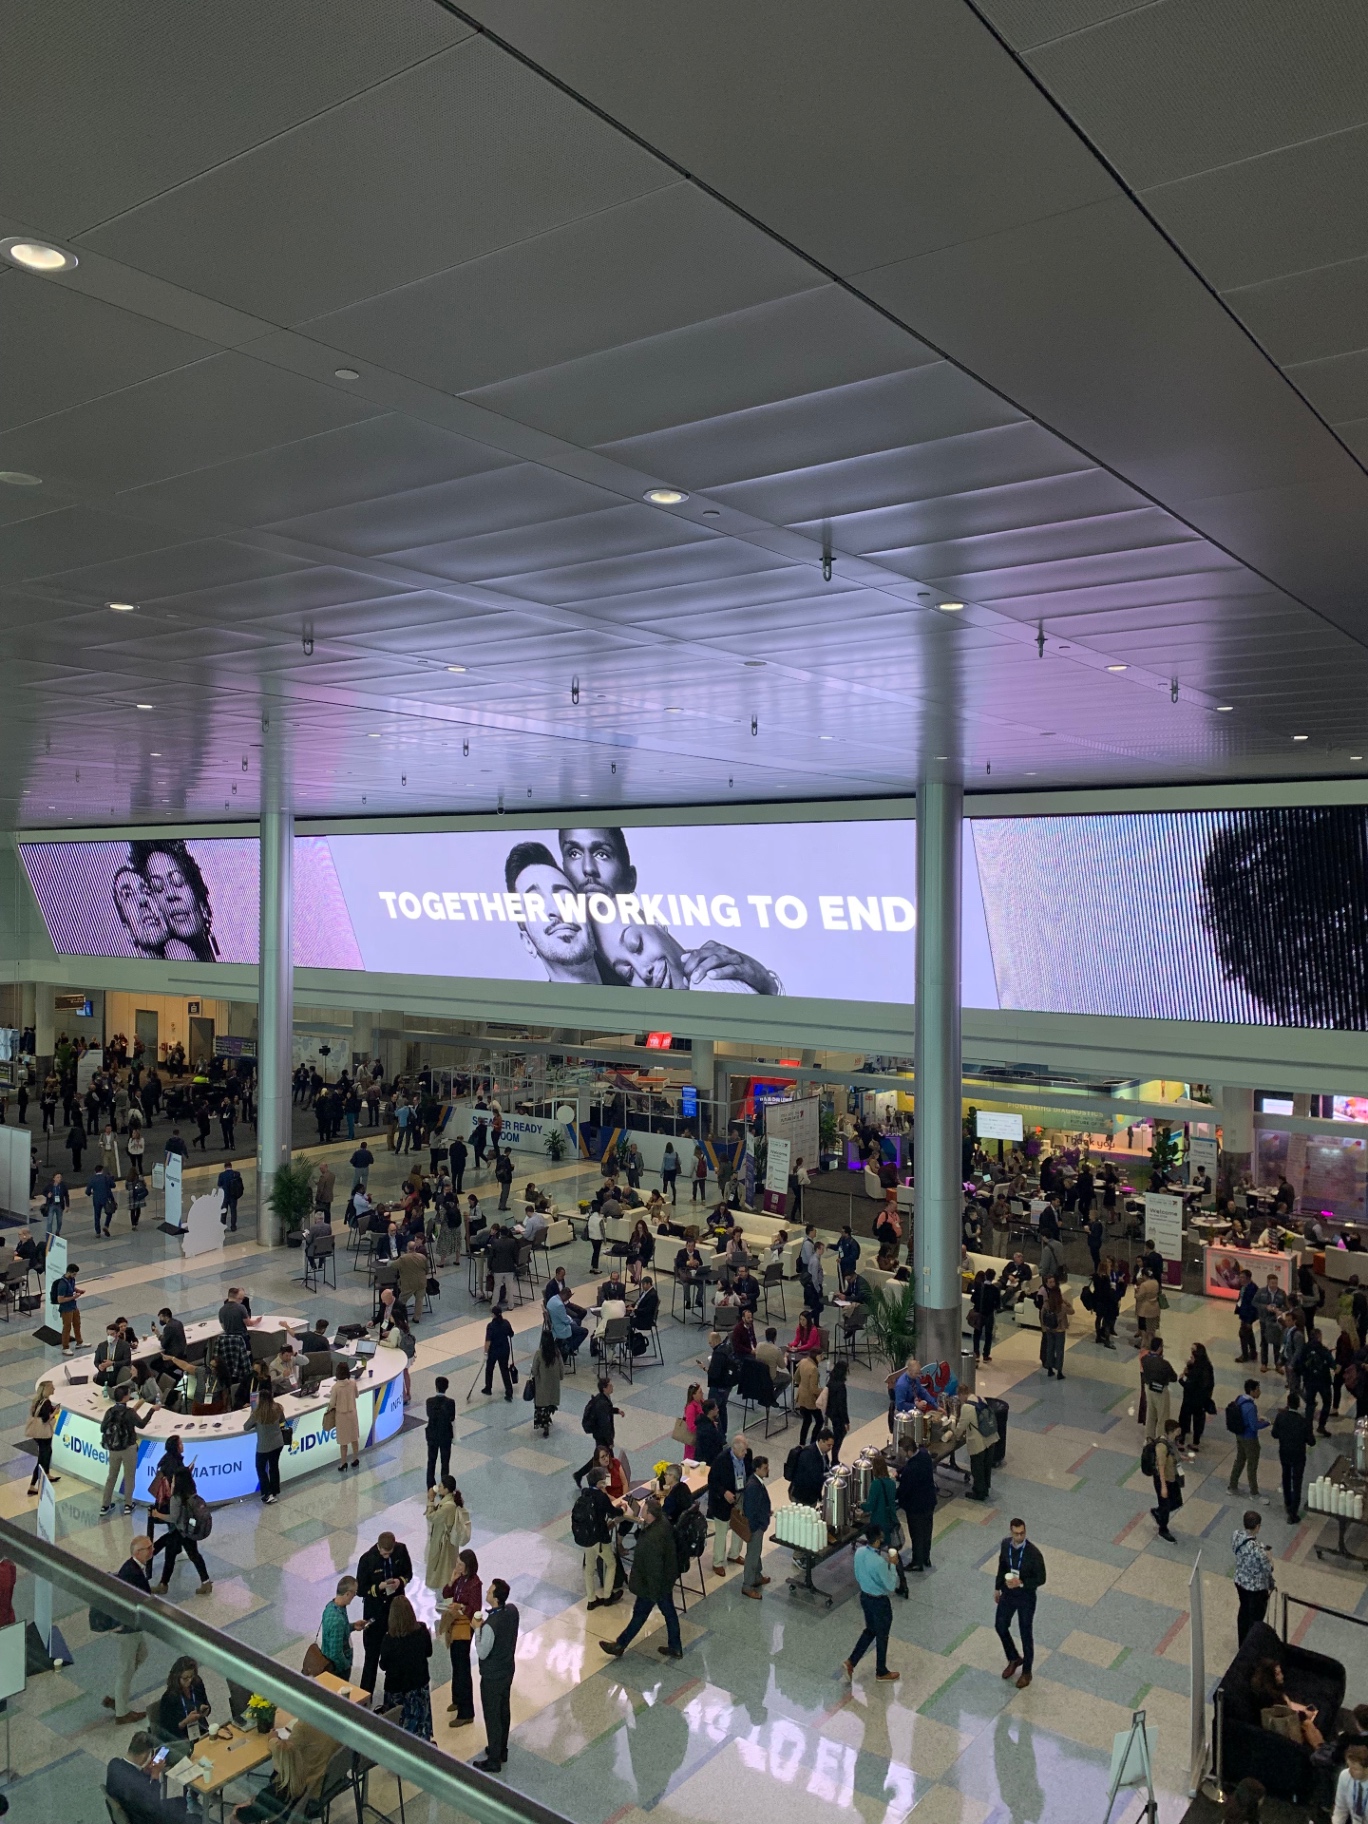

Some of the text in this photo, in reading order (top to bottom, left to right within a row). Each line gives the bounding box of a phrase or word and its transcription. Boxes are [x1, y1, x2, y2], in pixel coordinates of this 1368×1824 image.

[378, 891, 916, 932] TOGETHER WORKING TO END
[513, 1121, 543, 1134] READY
[500, 1131, 520, 1142] OOM
[301, 1428, 337, 1453] IDWe
[147, 1461, 242, 1478] INMATION
